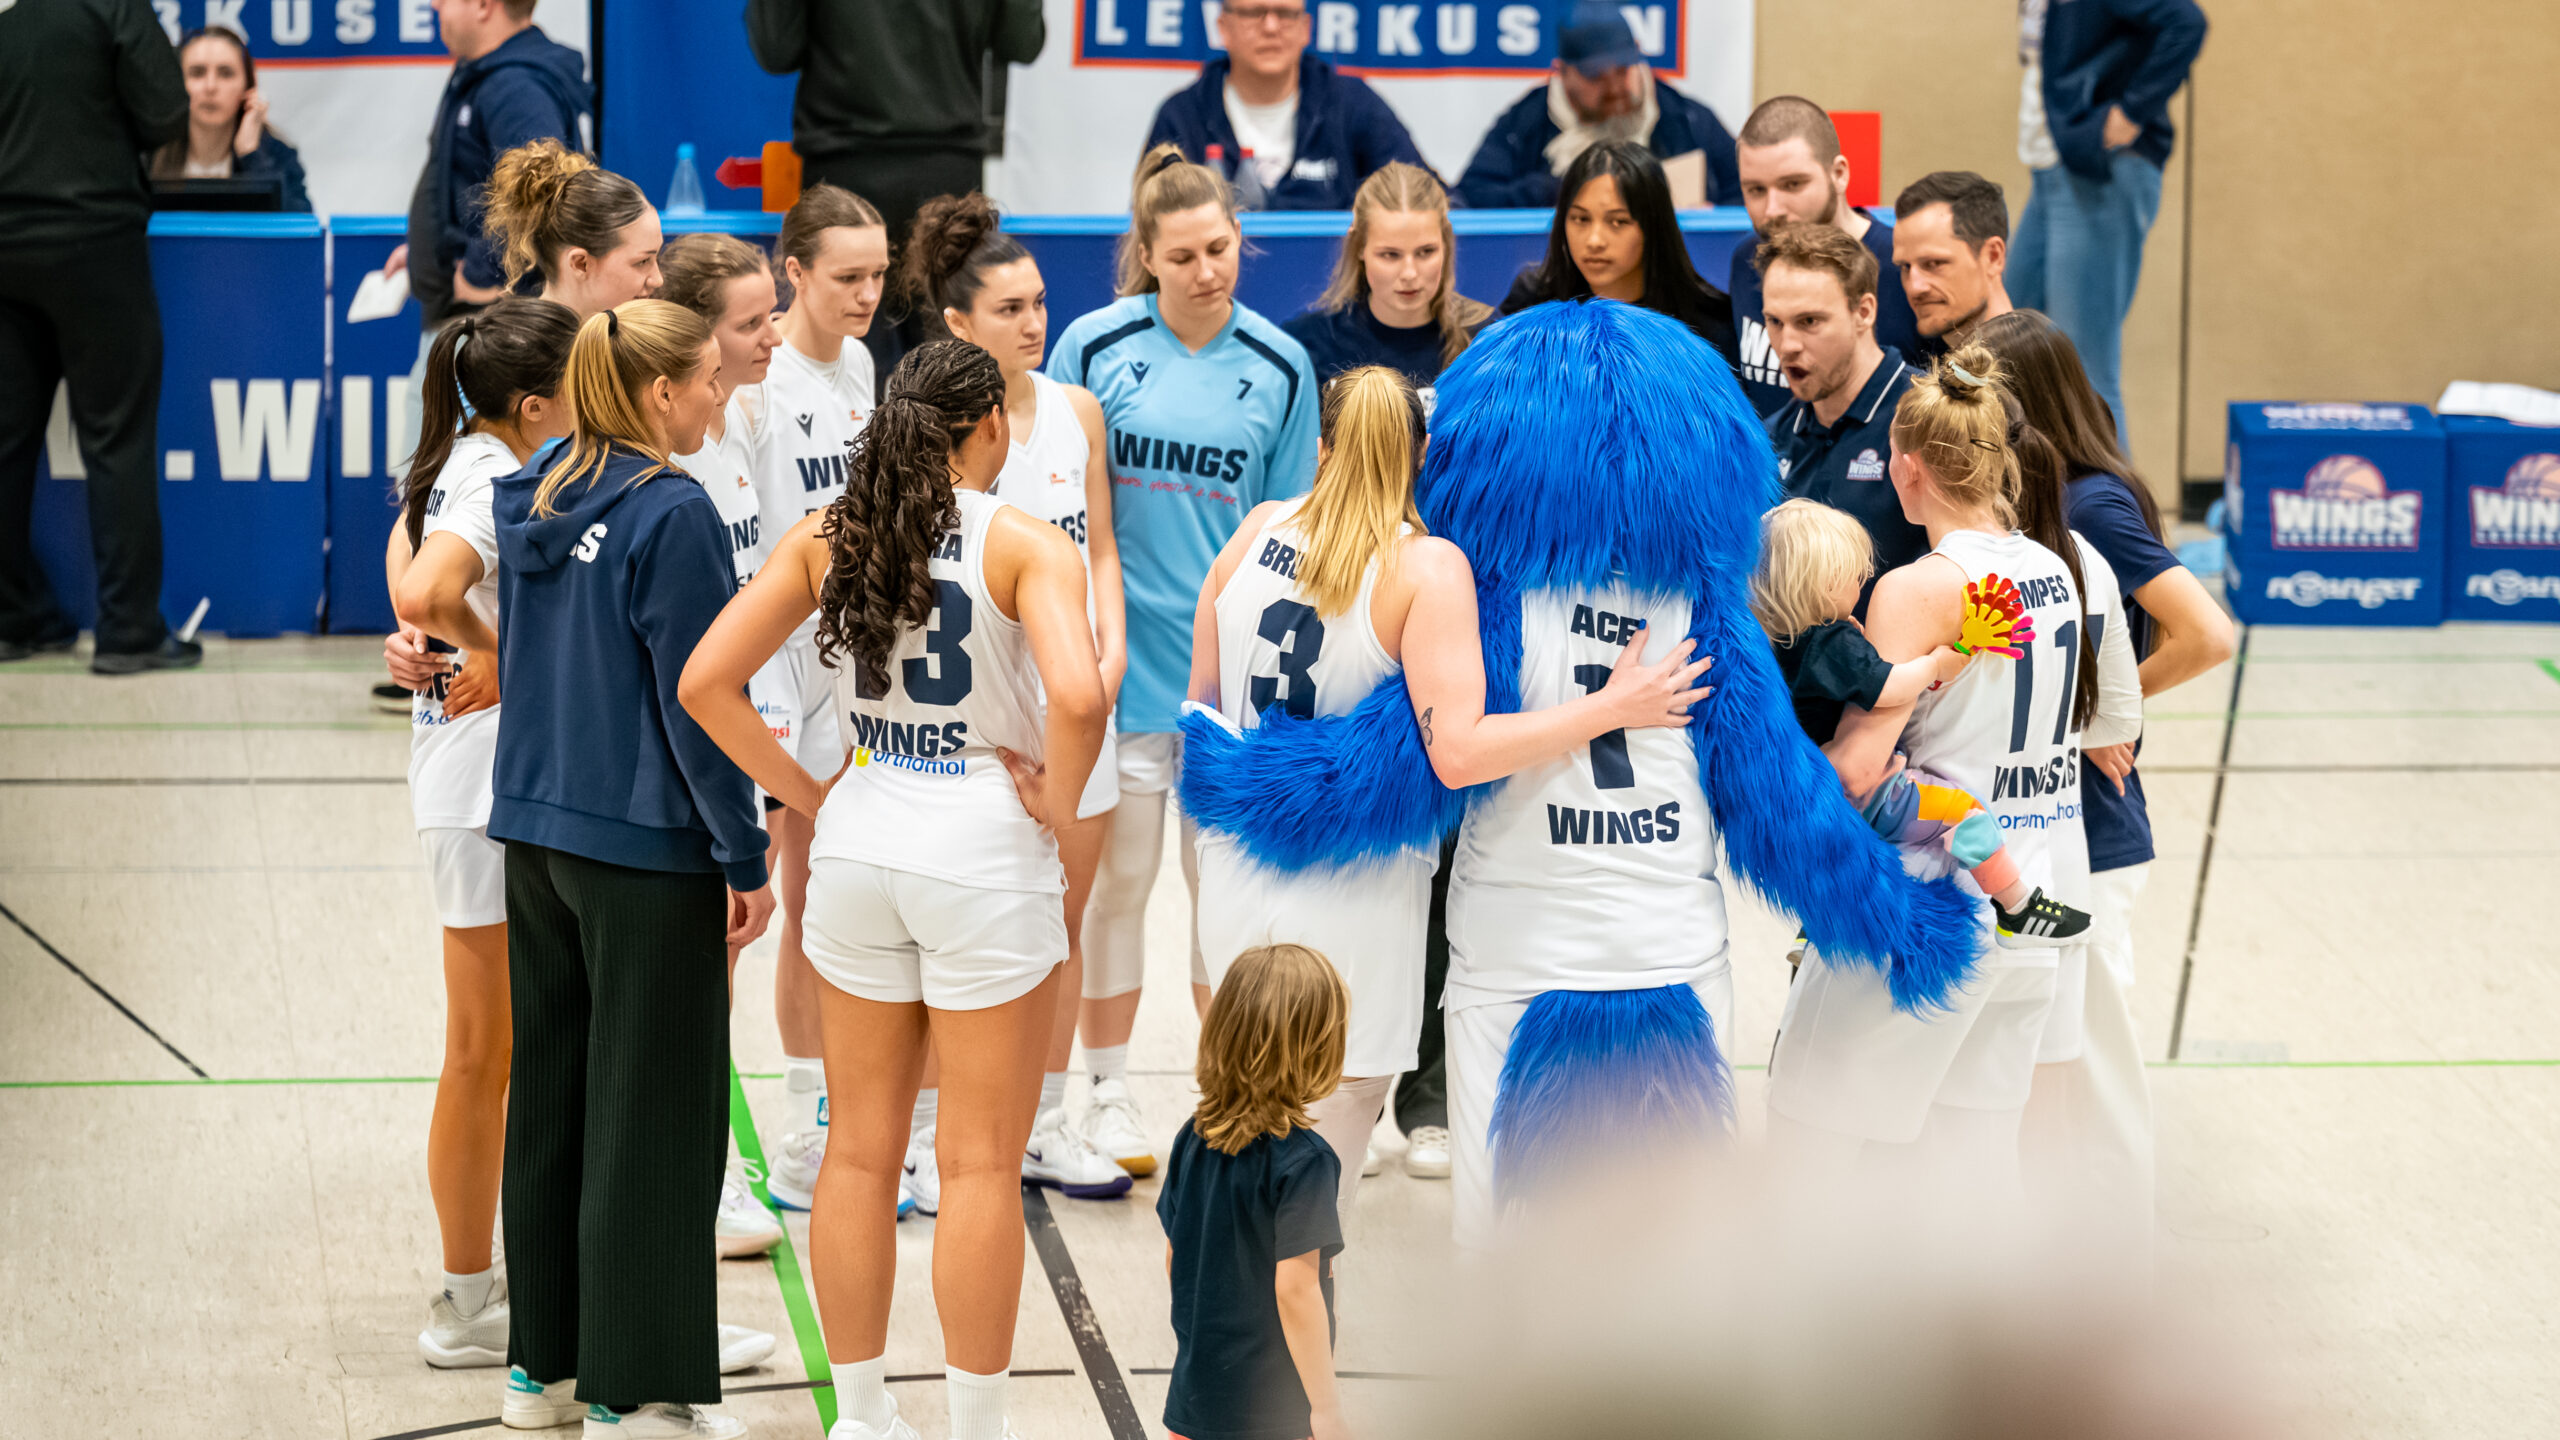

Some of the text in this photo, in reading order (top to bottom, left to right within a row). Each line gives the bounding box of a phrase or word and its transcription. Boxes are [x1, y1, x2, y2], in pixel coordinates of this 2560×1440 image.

[1237, 378, 1253, 400] 7
[1114, 428, 1249, 485] WINGS
[2273, 491, 2418, 534] WINGS
[1570, 603, 1642, 647] ACE
[1250, 598, 1325, 720] 3
[2009, 619, 2077, 754] 11
[850, 711, 968, 758] WINGS
[1546, 800, 1681, 845] WINGS
